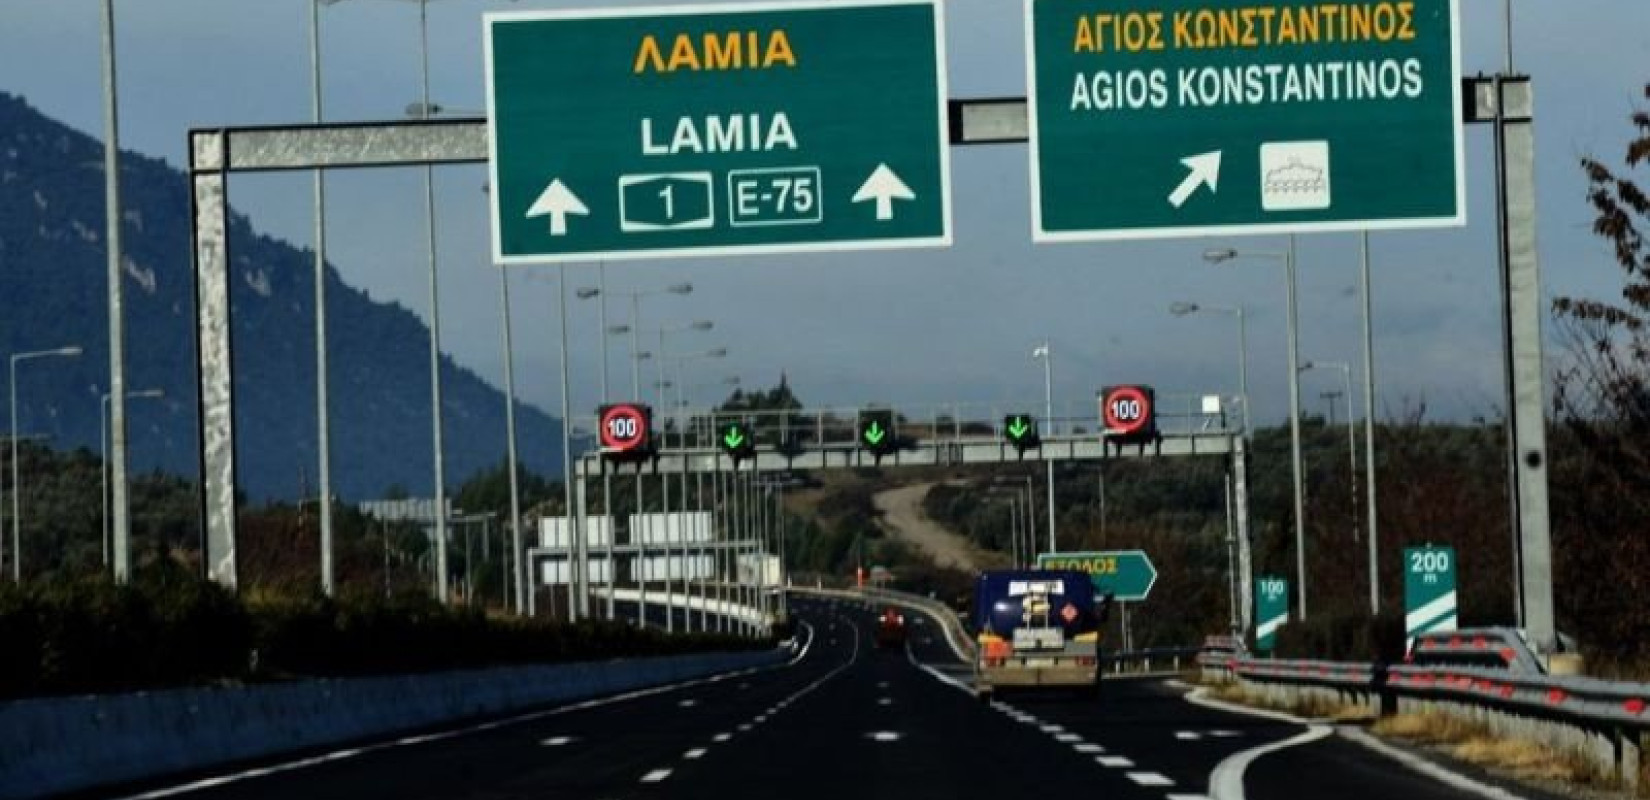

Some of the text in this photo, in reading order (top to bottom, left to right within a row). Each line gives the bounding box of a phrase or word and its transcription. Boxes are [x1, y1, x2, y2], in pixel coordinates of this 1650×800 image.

[1074, 2, 1416, 53] ΑΓΙΟΣ ΚΩΝΣΤΑΝΤΙΝΟΣ
[634, 29, 796, 72] ΛΑΜΙΑ
[1070, 58, 1422, 110] AGIOS KONSTANTINOS
[641, 111, 798, 155] LAMIA
[659, 185, 674, 219] 1
[737, 178, 813, 216] E-75
[1112, 400, 1140, 419] 100
[608, 417, 636, 437] 100
[1411, 552, 1449, 572] 200
[1423, 574, 1437, 583] m
[1261, 581, 1284, 595] 100
